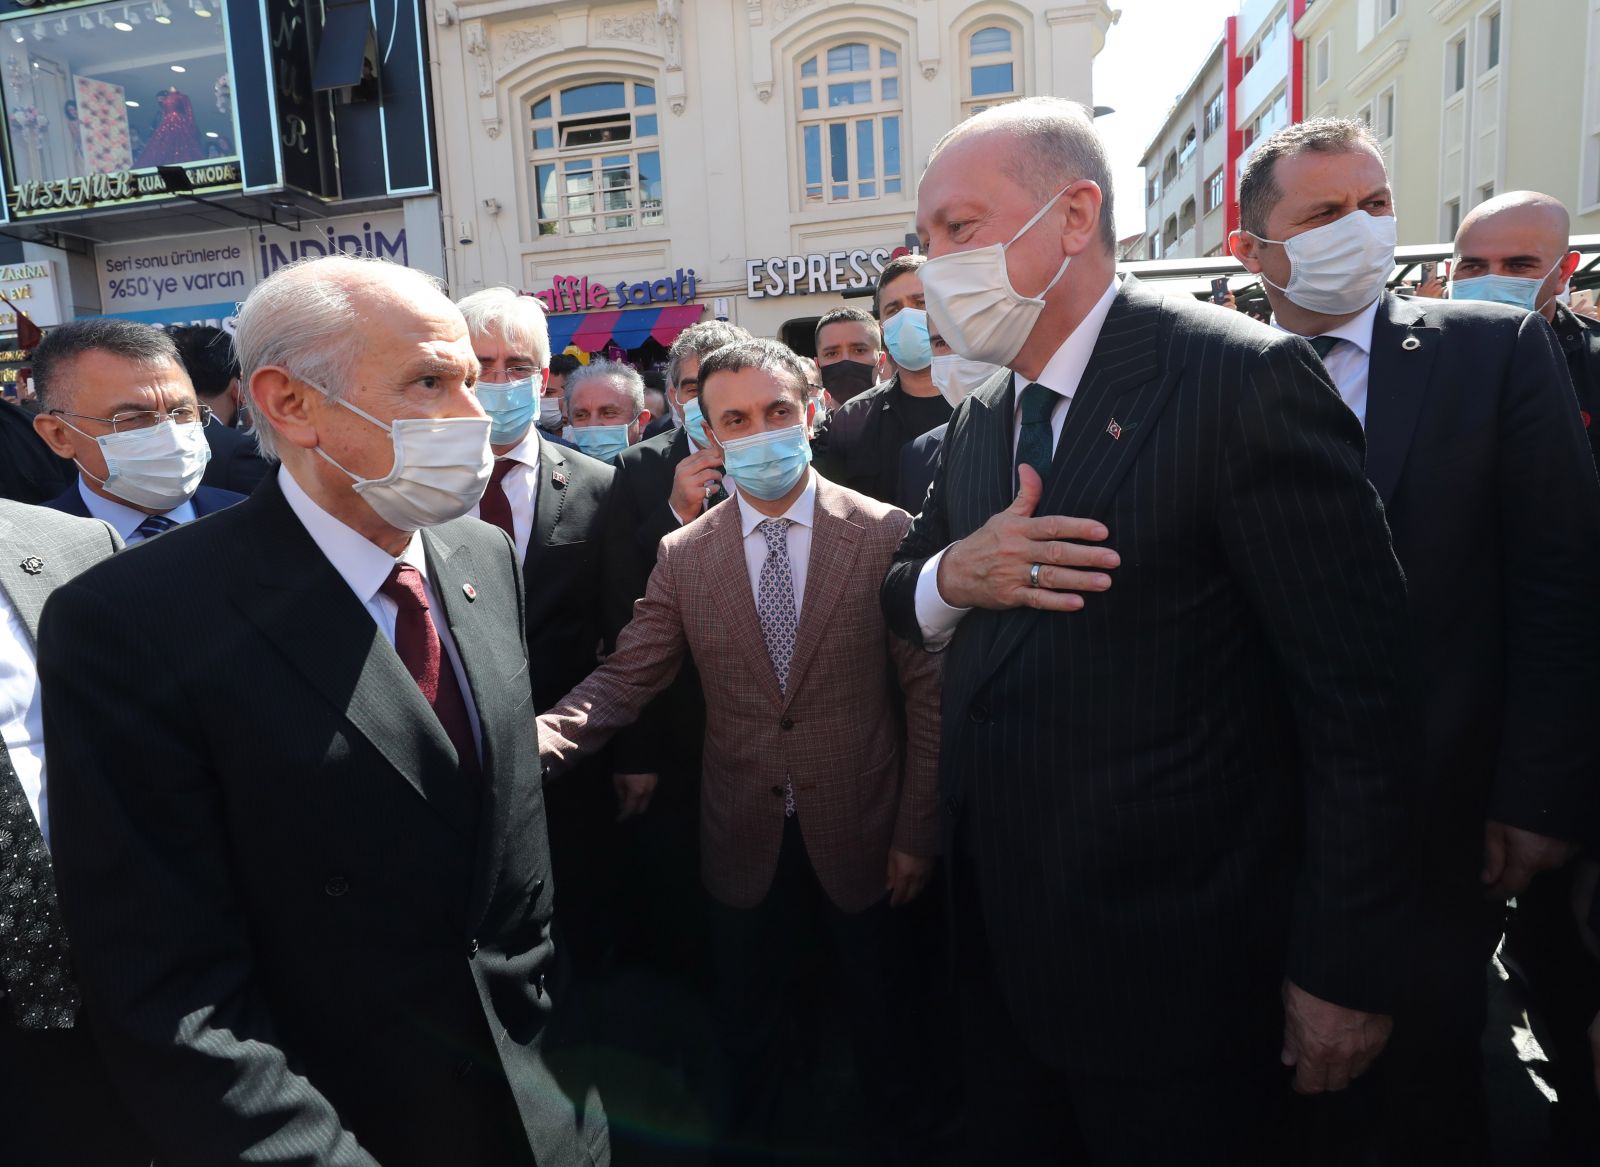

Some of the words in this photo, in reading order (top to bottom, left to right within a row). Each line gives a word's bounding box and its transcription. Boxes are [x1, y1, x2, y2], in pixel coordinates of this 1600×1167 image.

[106, 256, 132, 273] Seri
[135, 255, 168, 269] sonu
[171, 245, 240, 266] ürünlerde
[109, 276, 178, 301] %50'ye
[182, 270, 244, 292] varan
[519, 274, 610, 314] affle
[614, 267, 697, 310] saati
